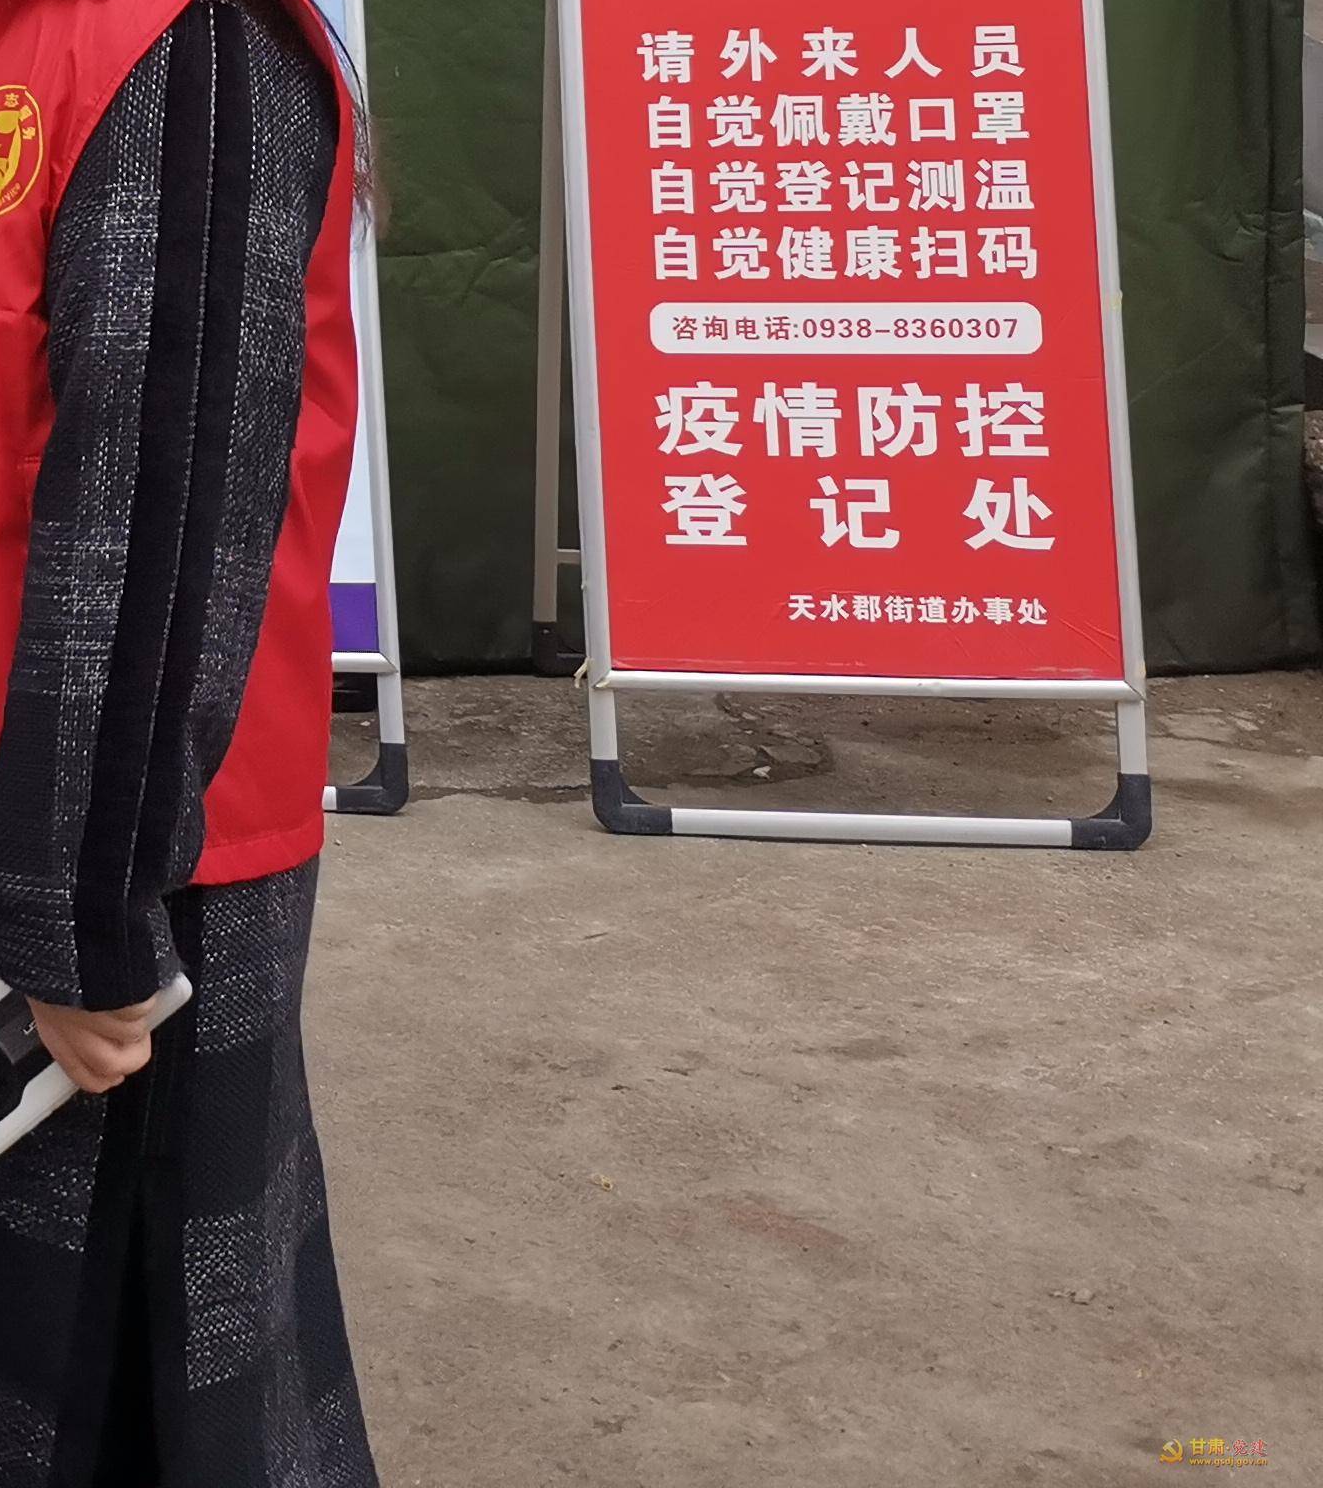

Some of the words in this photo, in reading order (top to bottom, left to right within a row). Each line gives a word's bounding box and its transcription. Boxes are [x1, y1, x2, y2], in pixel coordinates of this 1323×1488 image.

[636, 25, 1026, 84] 请外来人员
[647, 91, 1031, 149] 自觉佩戴口罩
[651, 159, 1035, 215] 自觉登记测温
[654, 225, 1038, 281] 自觉健康扫码
[655, 380, 1050, 458] 疫情防控
[661, 473, 1056, 551] 登记处
[788, 593, 1049, 625] 天水郡街道办事处
